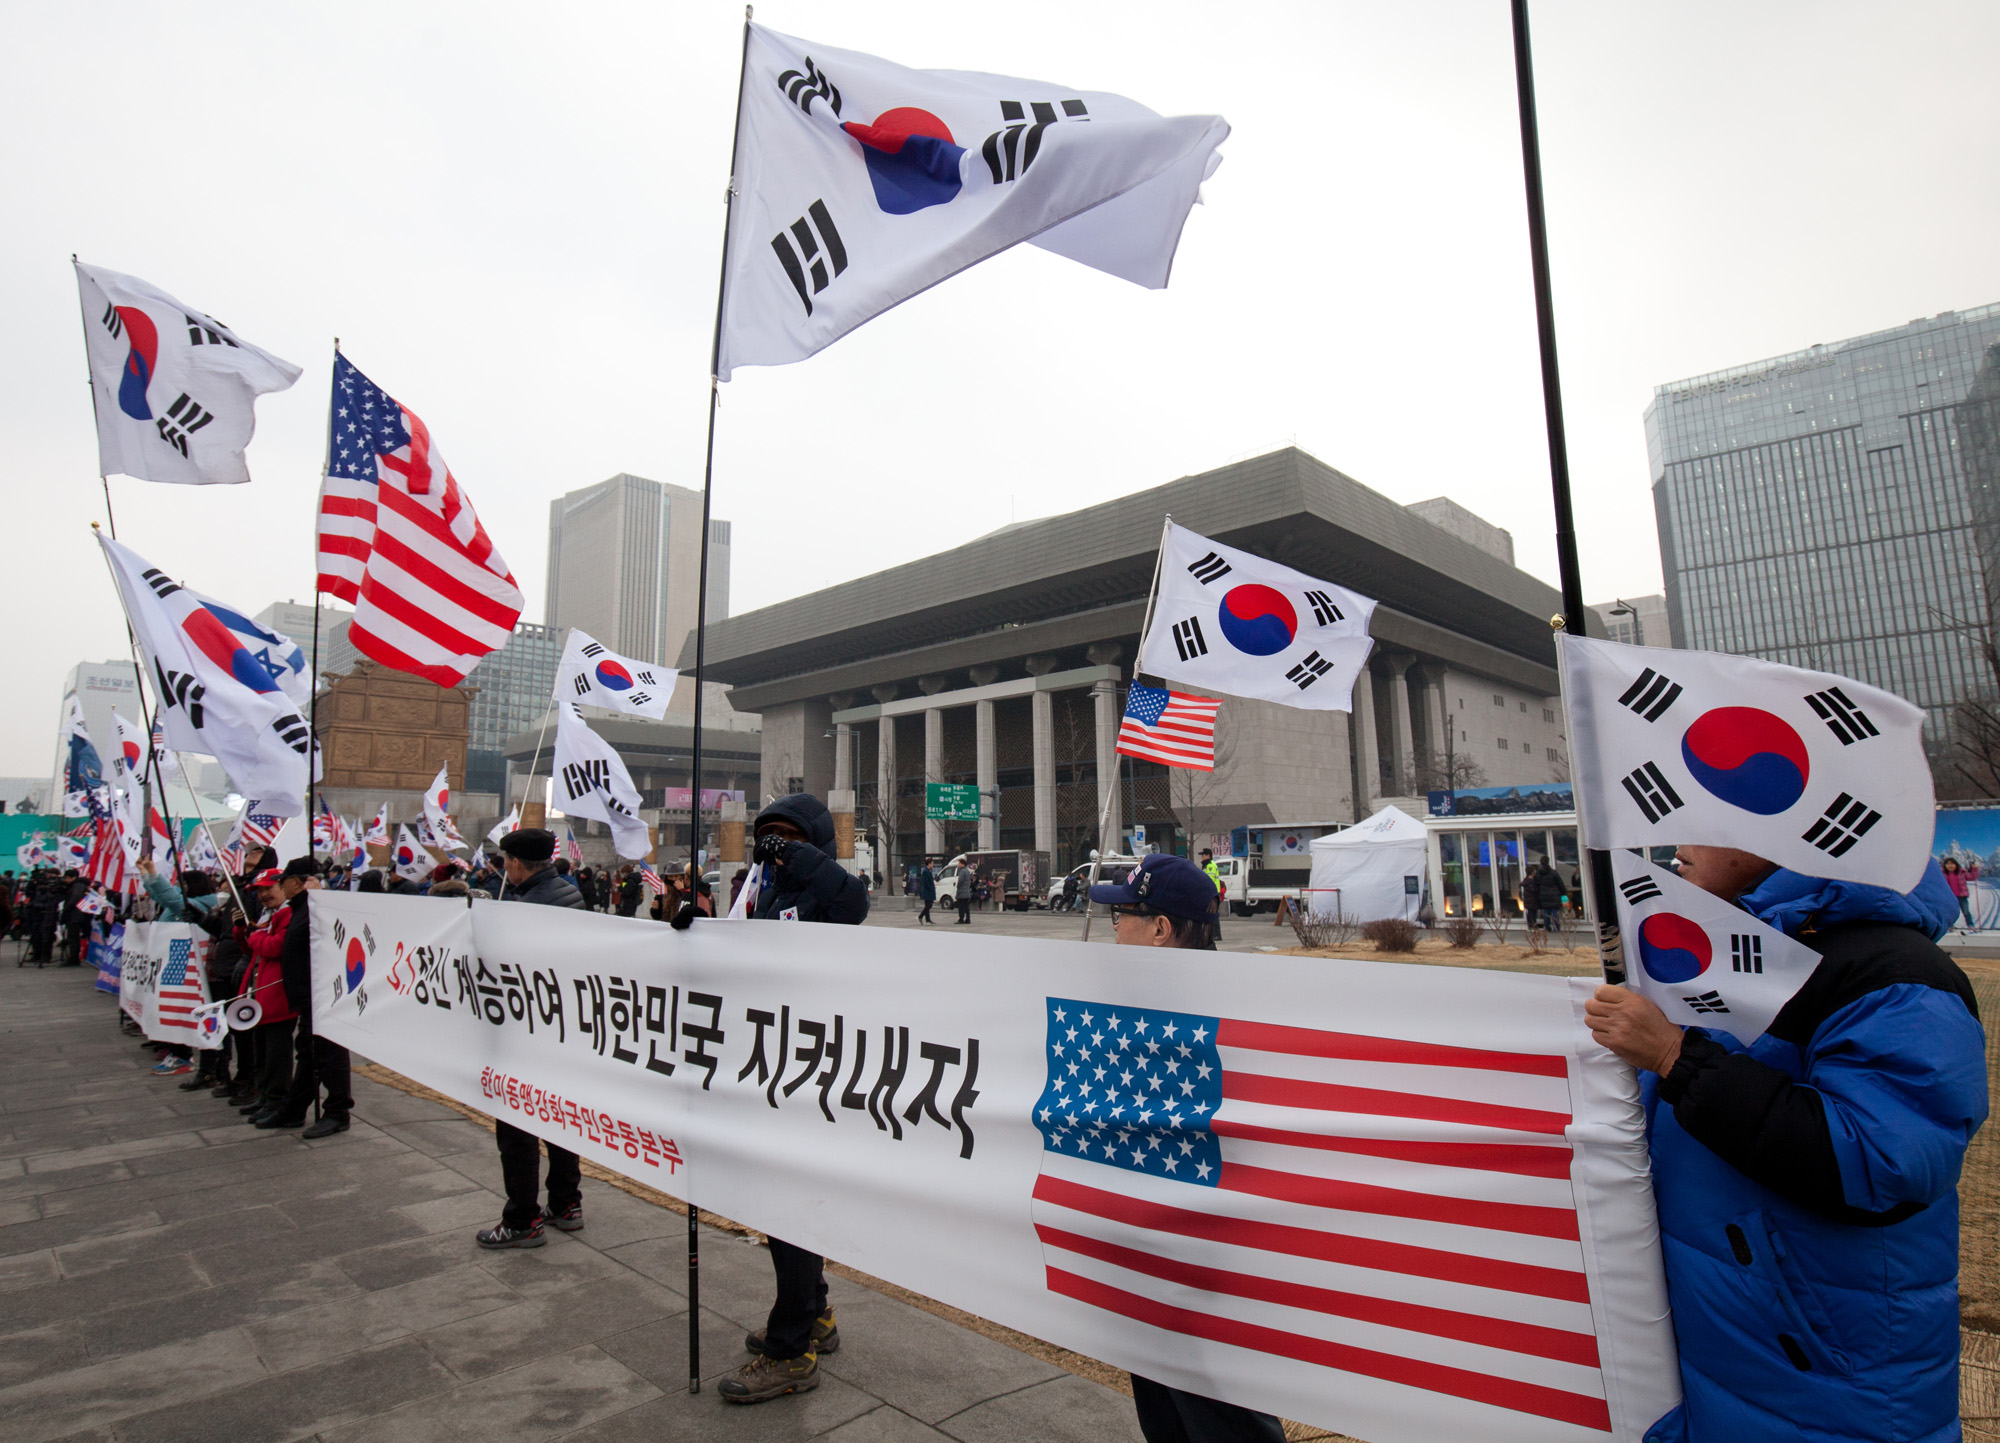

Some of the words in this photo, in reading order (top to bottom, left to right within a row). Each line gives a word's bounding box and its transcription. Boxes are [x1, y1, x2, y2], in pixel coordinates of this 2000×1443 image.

[452, 955, 565, 1043] 계승하여
[573, 974, 725, 1091] 대한민국
[737, 1004, 981, 1160] 지켜내자
[480, 1066, 684, 1175] 한미동맹강화국민운동본부
